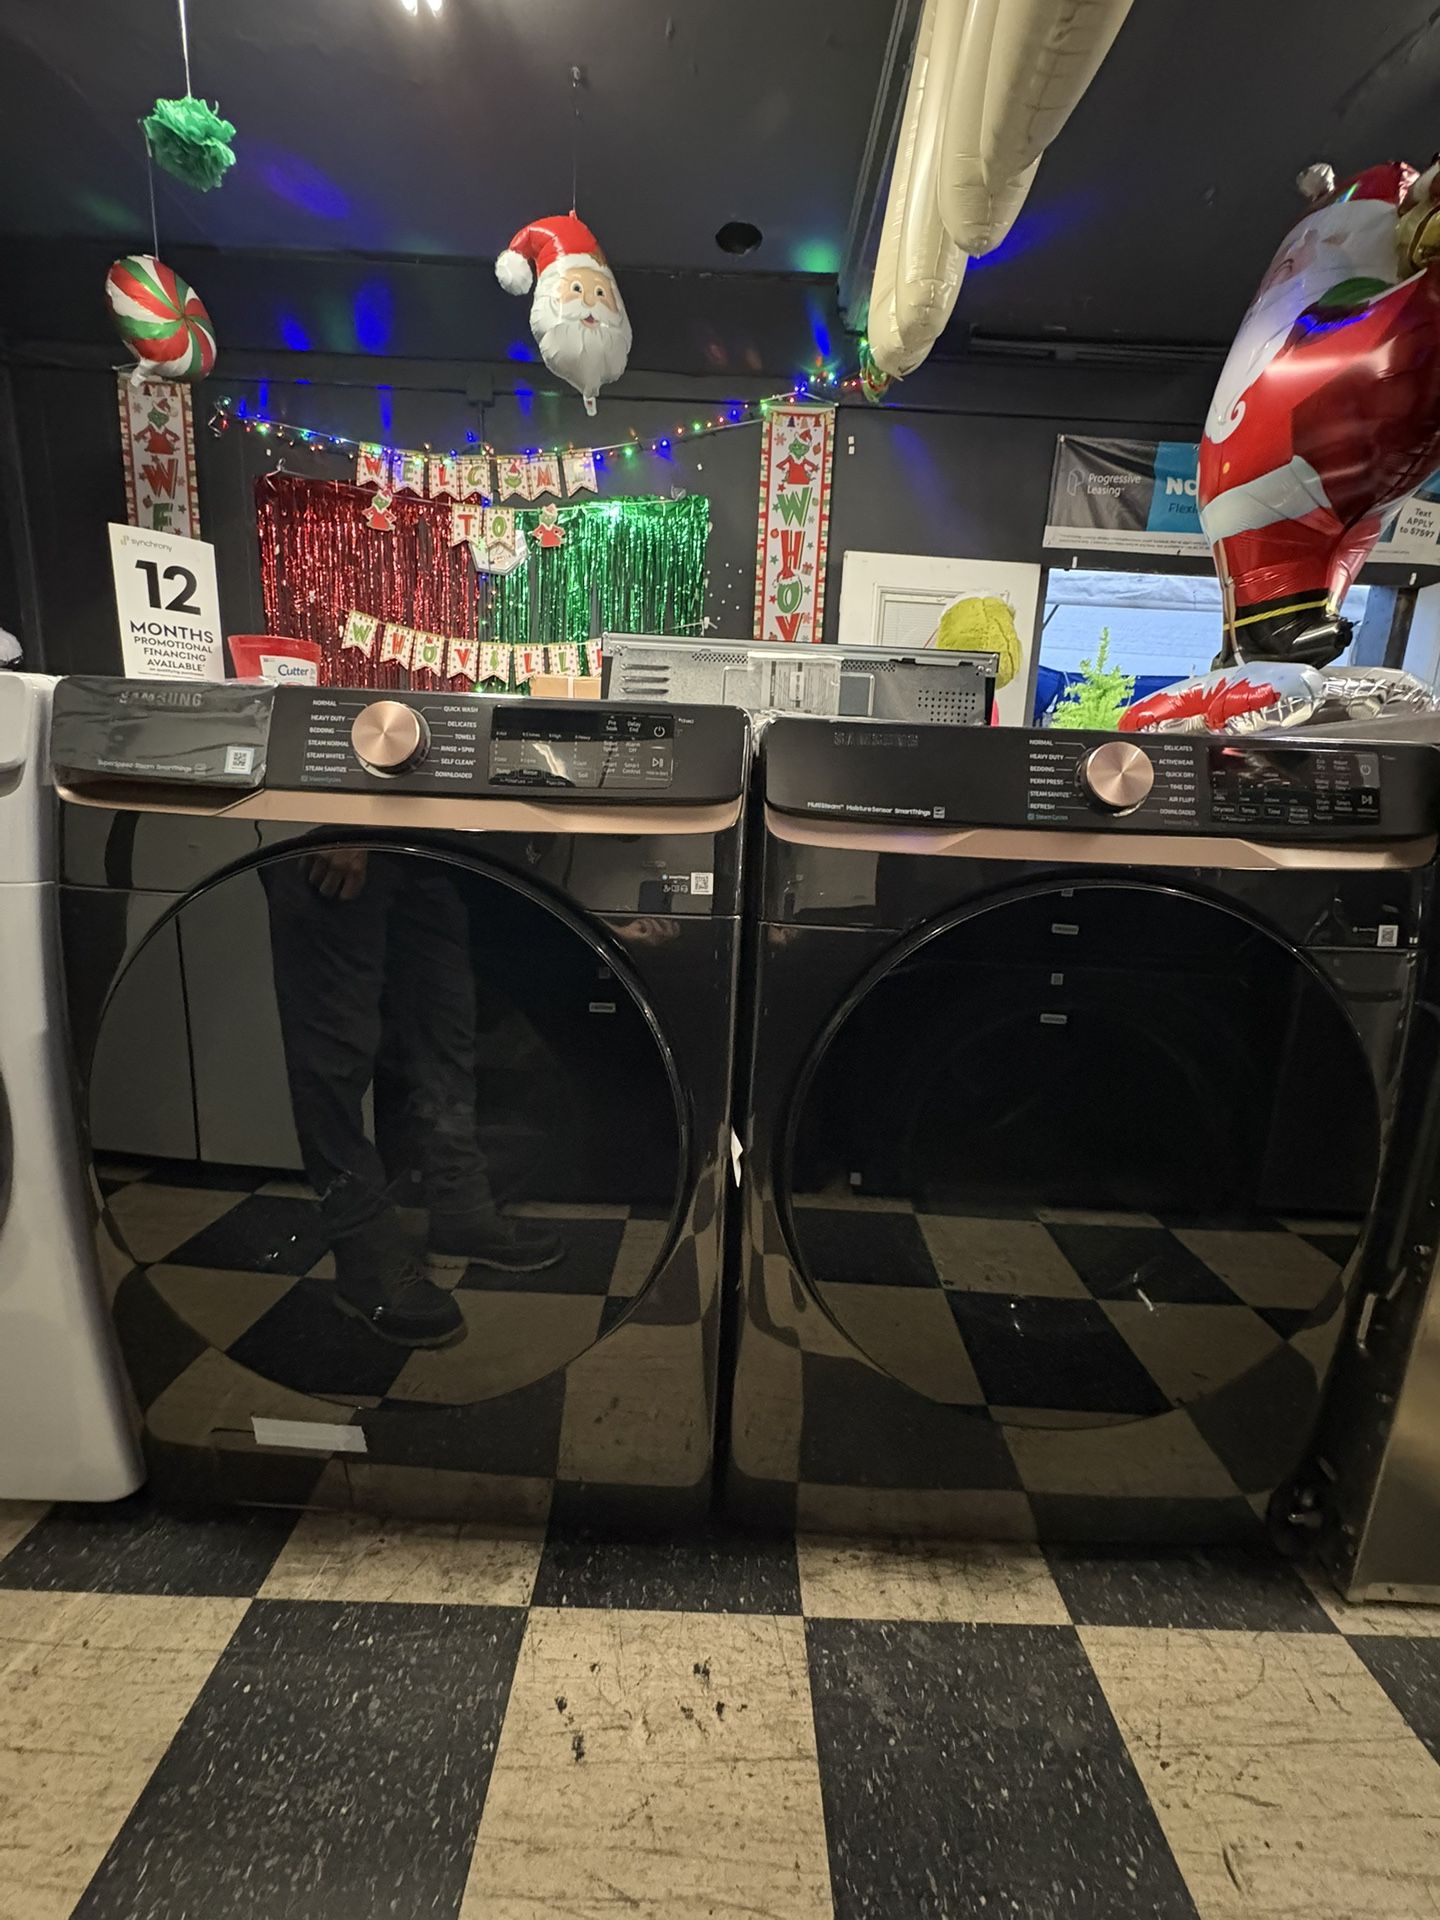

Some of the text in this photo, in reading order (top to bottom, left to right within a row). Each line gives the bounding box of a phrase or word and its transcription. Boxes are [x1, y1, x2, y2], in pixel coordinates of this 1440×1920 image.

[1088, 473, 1142, 485] Progressive
[1416, 508, 1432, 517] Text
[457, 514, 508, 537] TO
[1407, 517, 1434, 528] APPLY
[1409, 527, 1435, 538] 57597
[131, 537, 172, 552] synchrony
[135, 559, 202, 616] 12
[129, 620, 214, 644] MONTHS
[134, 636, 213, 653] PROMOTIONAL
[144, 647, 206, 662] FINANCING
[278, 664, 309, 676] Cutter
[119, 691, 202, 707] SAMSUNG
[1163, 744, 1193, 752] DELICATES
[1158, 758, 1194, 766] ACTIVEWEAR
[434, 771, 473, 779] DOWNLOADED
[1159, 808, 1196, 816] DOWNLOADED
